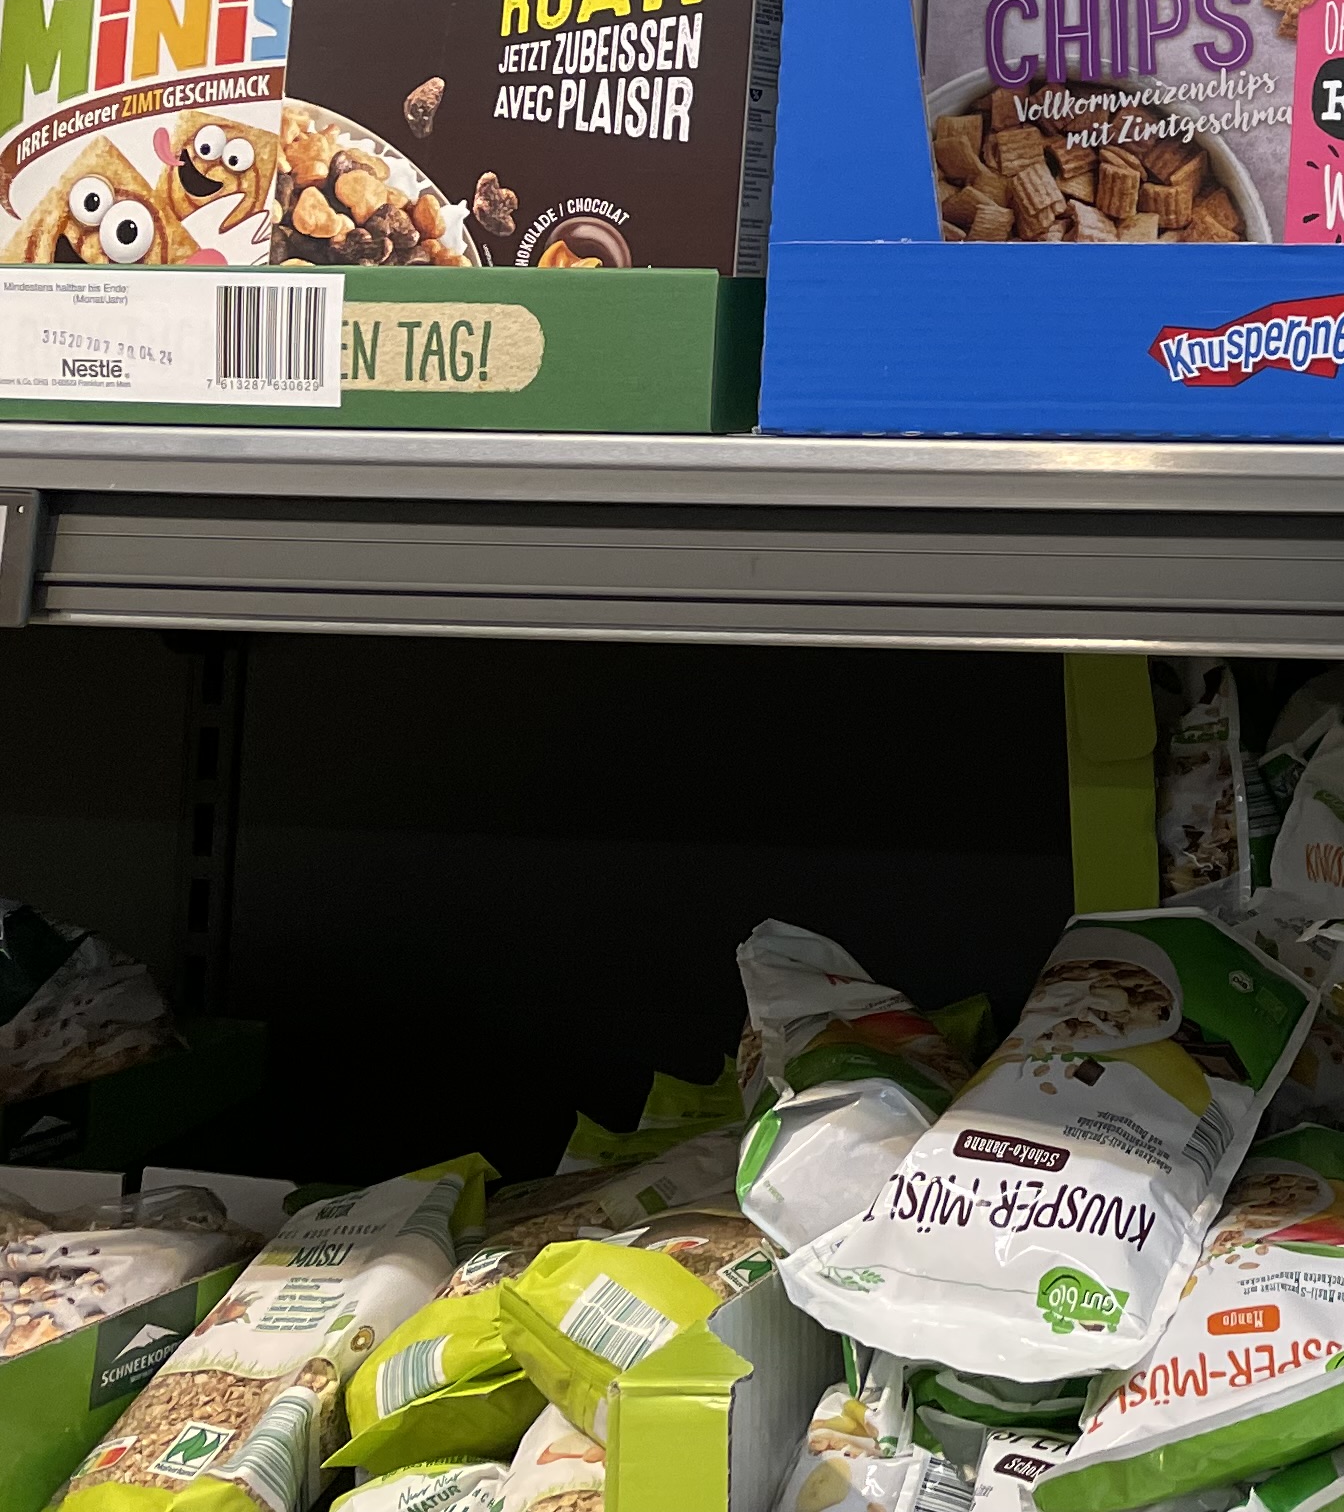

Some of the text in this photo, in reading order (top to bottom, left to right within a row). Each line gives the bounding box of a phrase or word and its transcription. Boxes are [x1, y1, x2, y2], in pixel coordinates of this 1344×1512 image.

[498, 13, 703, 76] JETZT ZUBEISSEN
[16, 74, 270, 165] IRRE leckerer ZIMTGESCHMACK
[494, 77, 694, 143] AVEC PLAISIR
[1014, 69, 1278, 125] Vollkornweizenchips
[1066, 99, 1293, 151] mit Zimtgeschma
[515, 208, 558, 267] HOKOLADE
[566, 197, 630, 226] CHOCOLAT
[62, 358, 130, 379] Nestlé
[397, 320, 491, 382] TAG!
[220, 379, 320, 392] 613287 630629
[962, 1134, 1062, 1168] Schoko-Banane
[287, 1241, 354, 1267] MÜSLI
[1221, 1308, 1266, 1329] Mango
[101, 1343, 178, 1387] SCHNEEKOP
